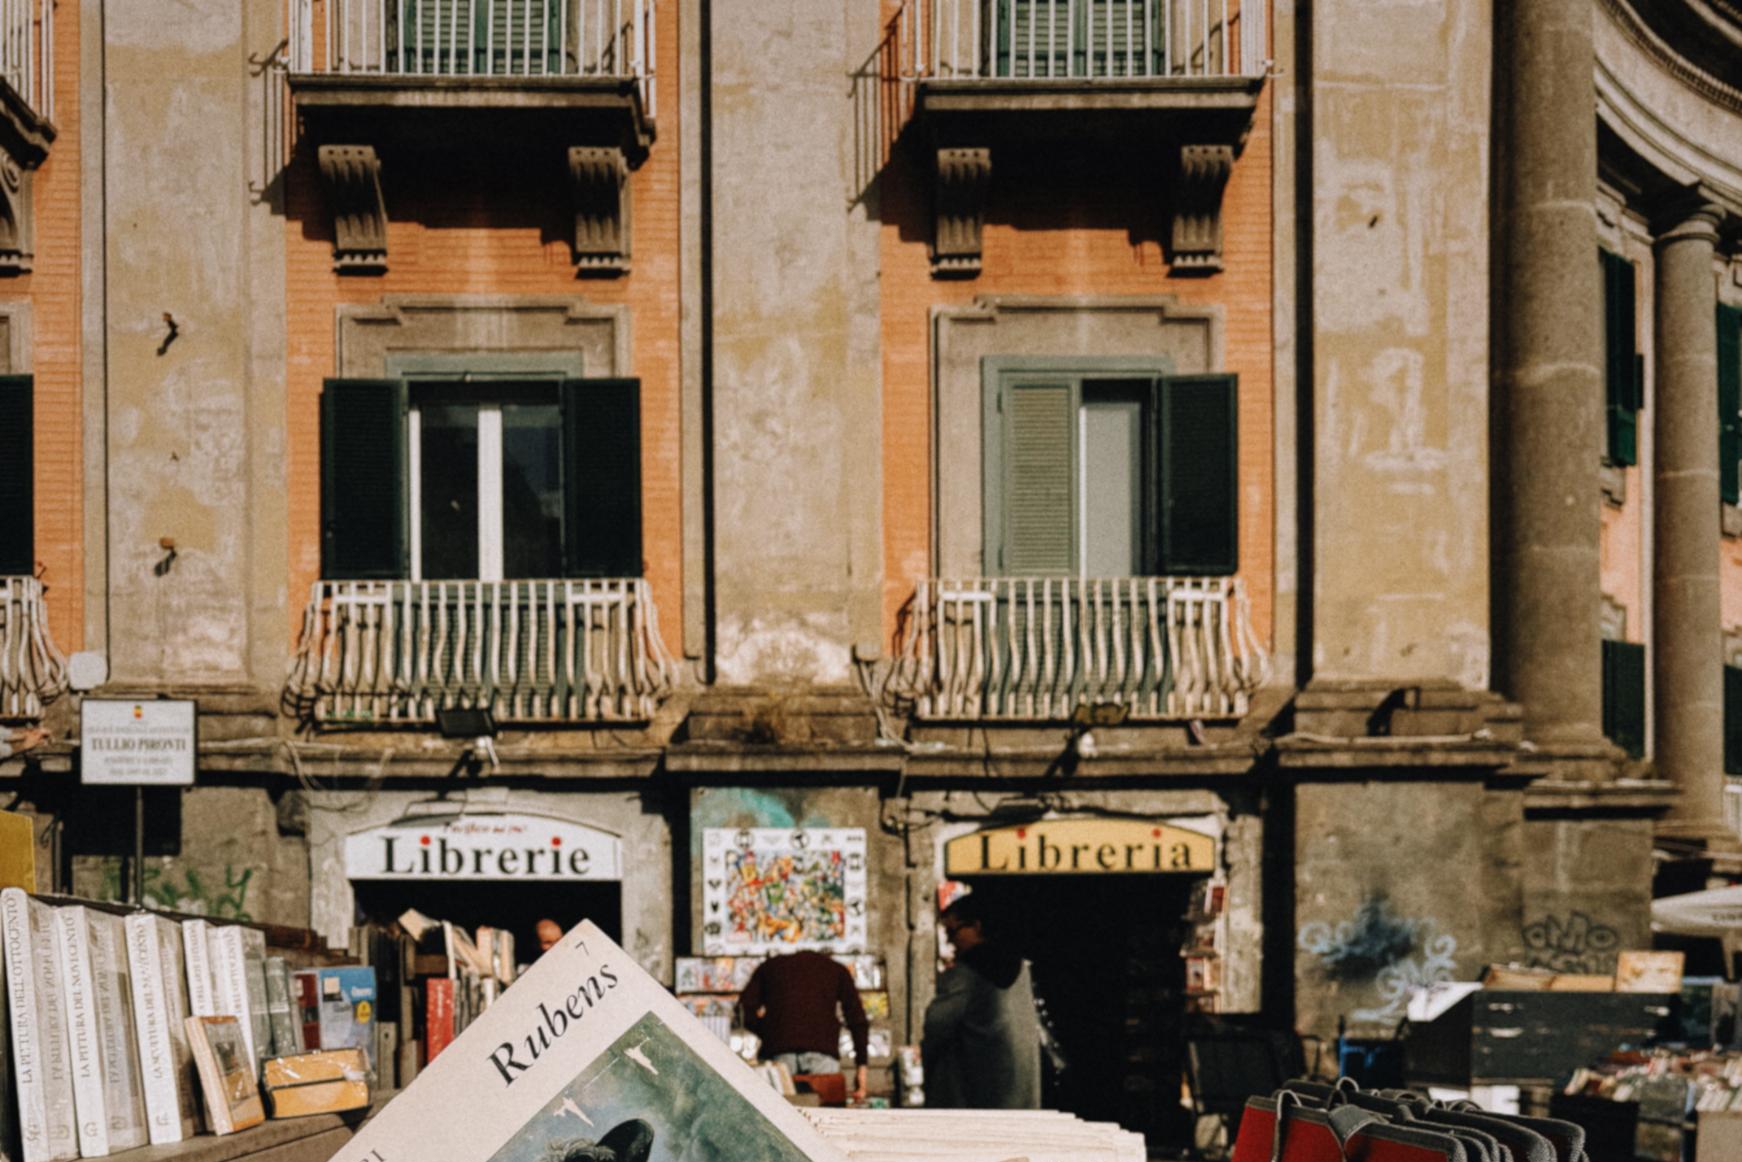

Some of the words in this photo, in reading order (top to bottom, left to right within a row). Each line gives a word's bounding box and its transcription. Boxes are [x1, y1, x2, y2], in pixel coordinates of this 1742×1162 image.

[379, 835, 590, 875] Librerie
[978, 828, 1193, 871] Libreria
[575, 941, 590, 956] 7
[486, 963, 619, 1088] Rubens
